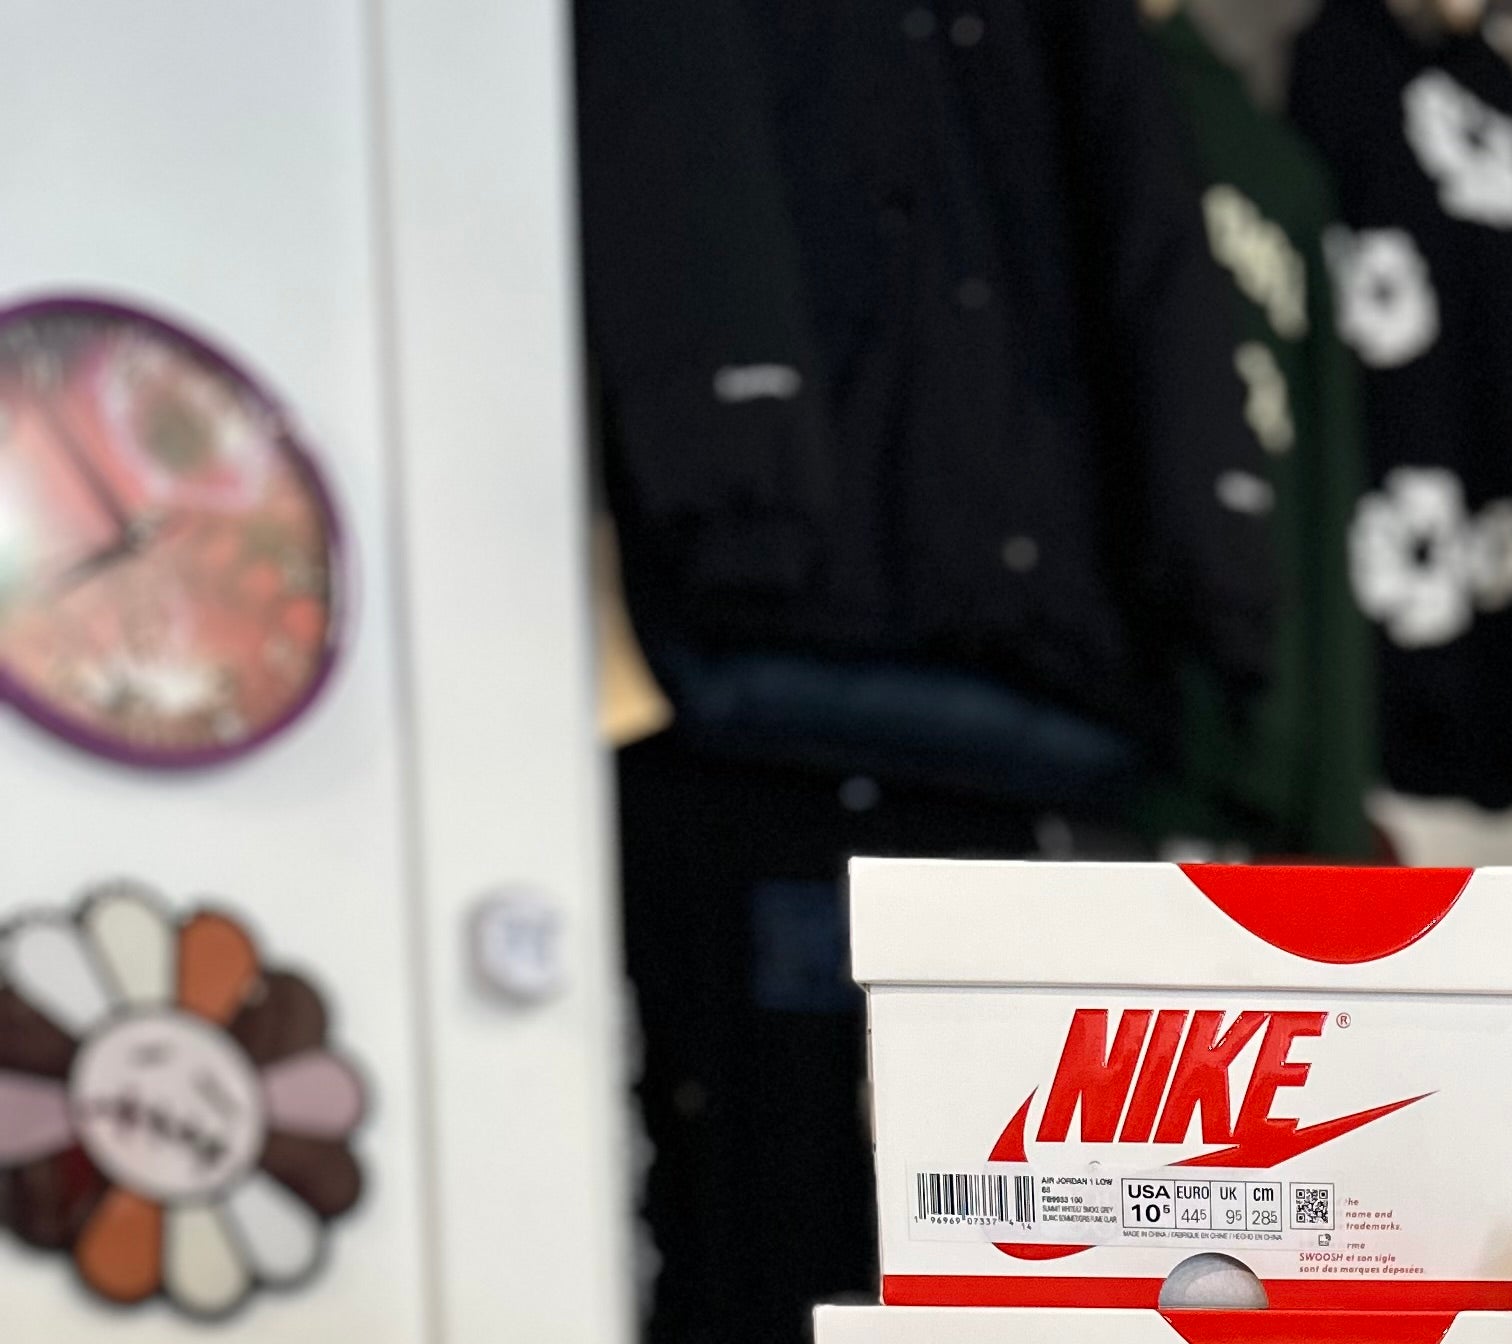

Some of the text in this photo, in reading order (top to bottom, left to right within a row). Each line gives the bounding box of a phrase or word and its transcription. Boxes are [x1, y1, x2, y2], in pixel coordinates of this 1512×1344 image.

[1036, 1008, 1329, 1143] NIKE
[1128, 1185, 1274, 1201] USA EURO UK cm
[1300, 1253, 1342, 1261] SWOOSH
[1375, 1254, 1395, 1263] sigle
